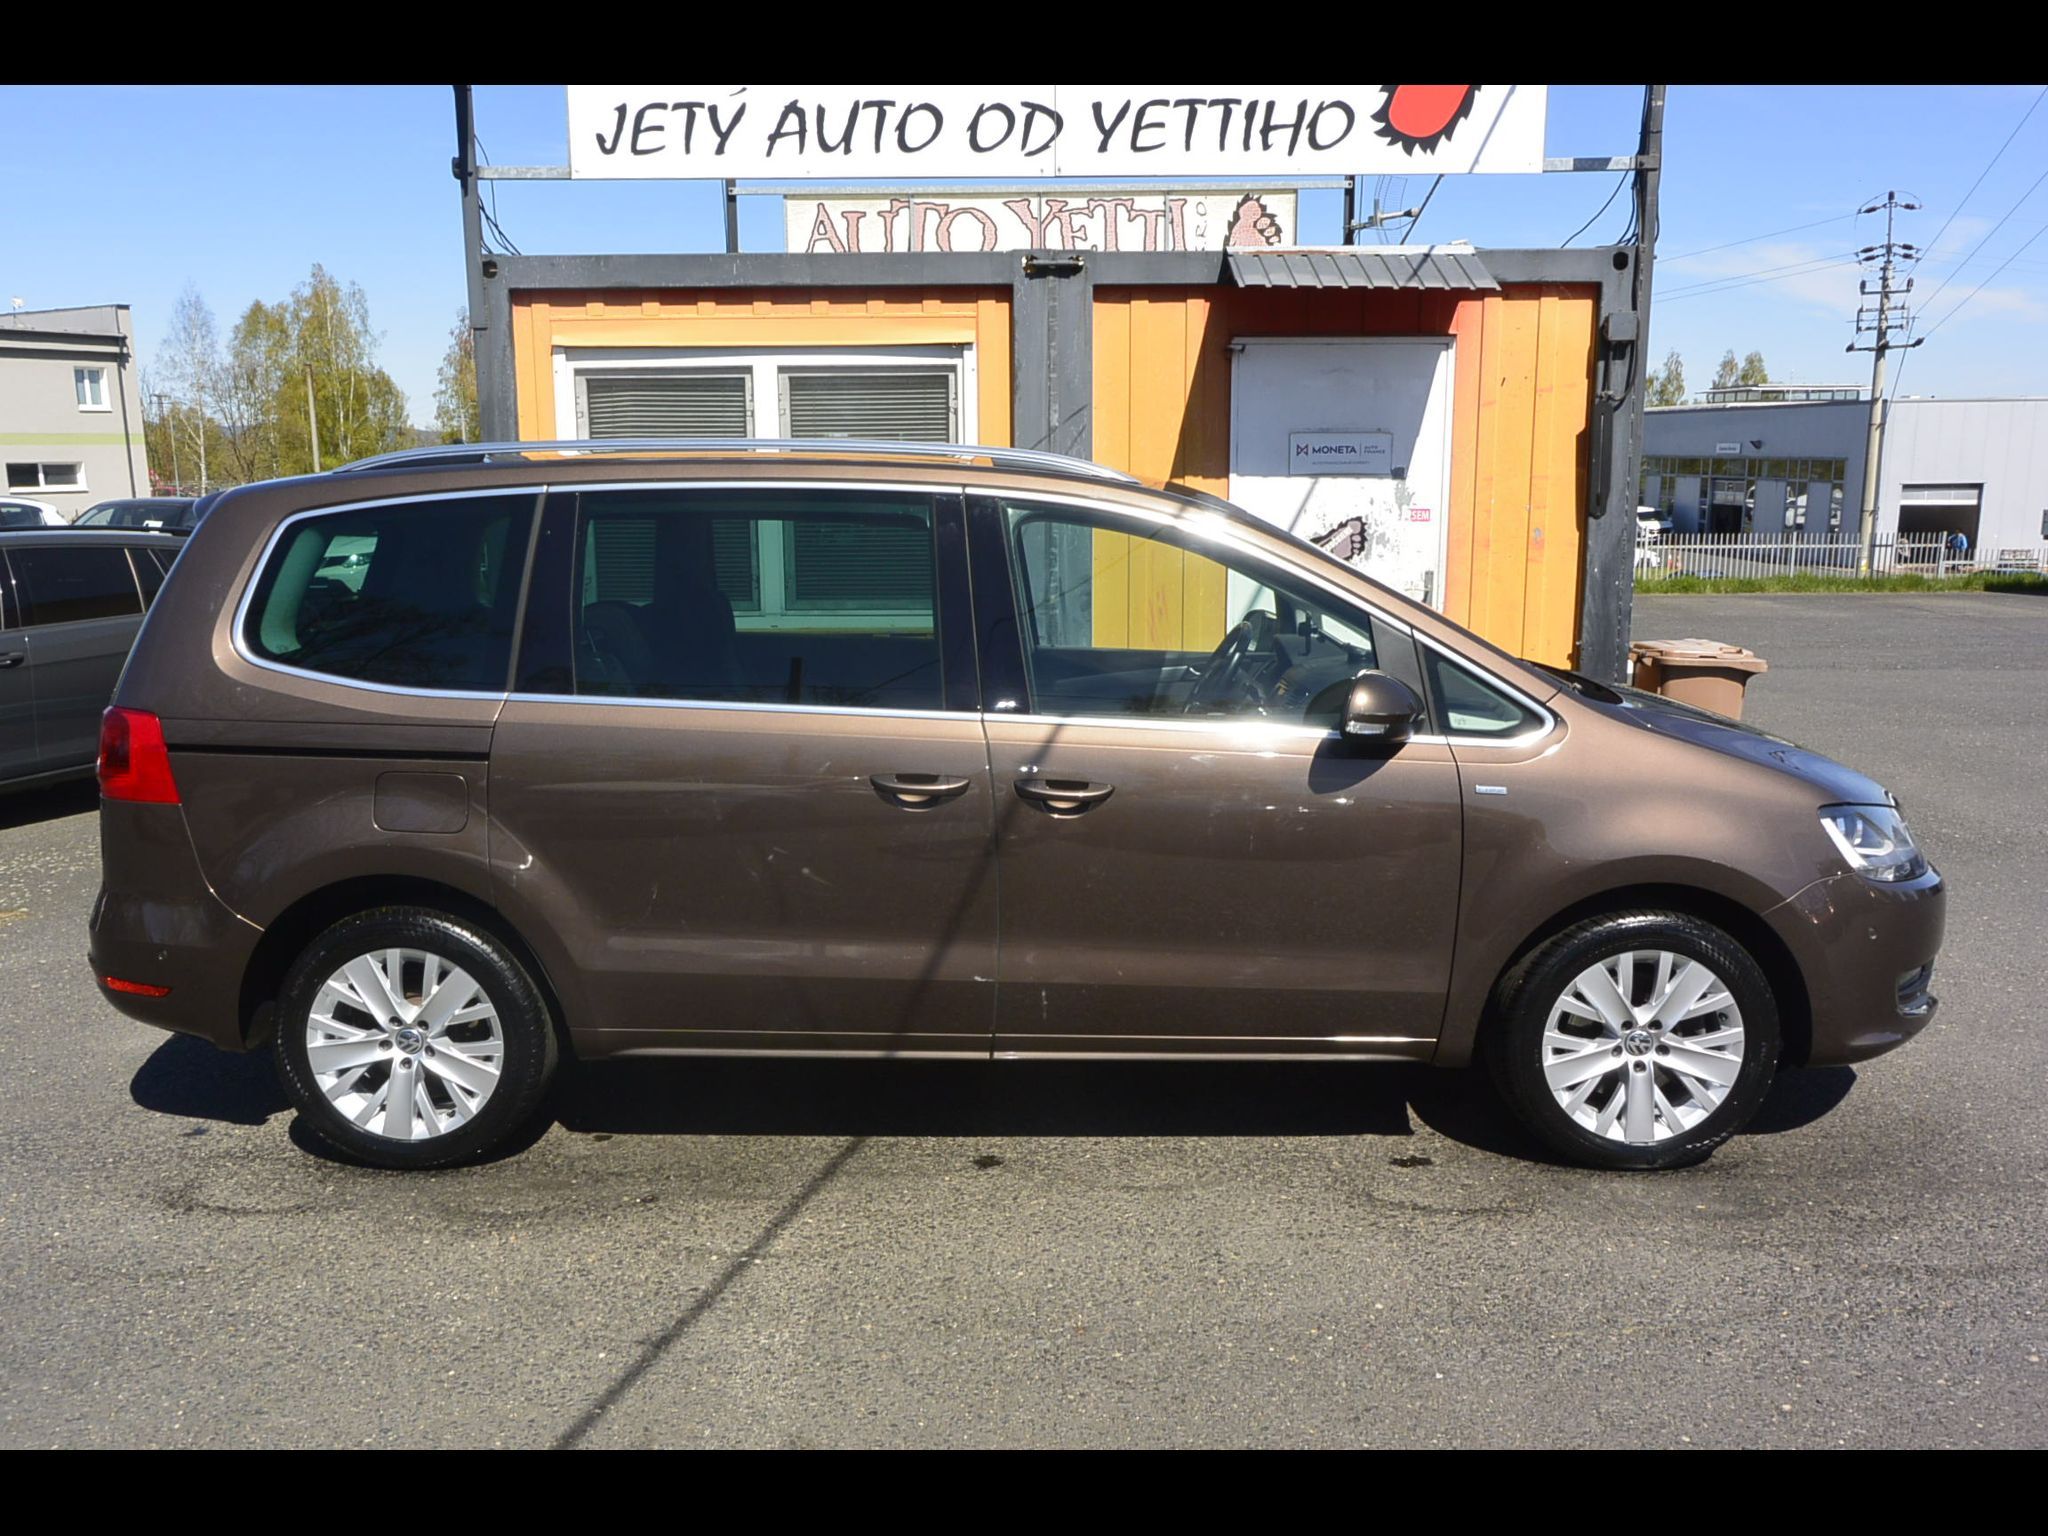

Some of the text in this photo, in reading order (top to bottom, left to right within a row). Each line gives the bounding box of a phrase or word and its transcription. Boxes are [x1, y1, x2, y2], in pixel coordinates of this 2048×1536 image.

[595, 87, 1356, 157] JETÝ AUTO OD YETTIHO
[805, 198, 1187, 253] AUTO YETTI
[1312, 445, 1357, 455] MONETA
[1411, 510, 1430, 521] SEM
